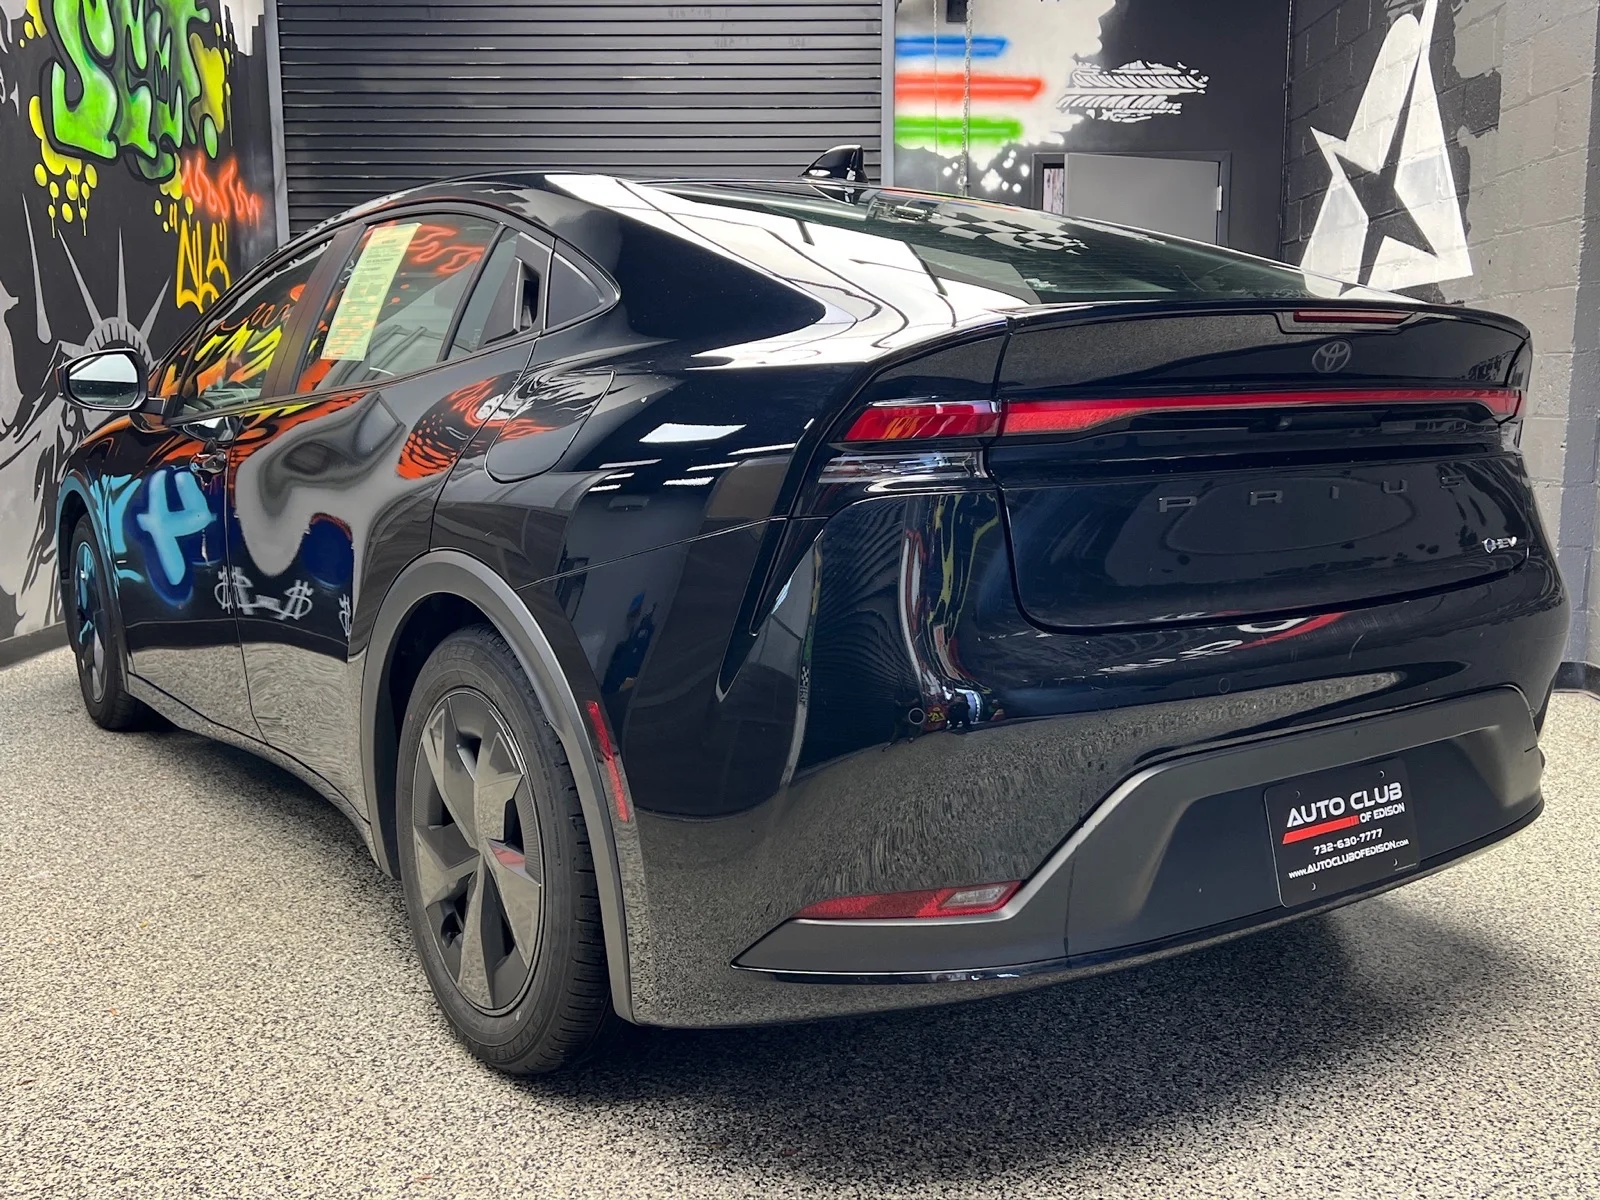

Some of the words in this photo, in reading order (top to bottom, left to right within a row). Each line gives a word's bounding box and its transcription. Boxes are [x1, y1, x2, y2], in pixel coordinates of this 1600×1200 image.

[1159, 474, 1466, 513] PRIUS
[1286, 797, 1345, 828] AUTO
[1350, 782, 1403, 810] CLUB
[1360, 811, 1372, 823] OF
[1373, 802, 1406, 820] EDISON
[1313, 828, 1383, 856] 732-630-7777
